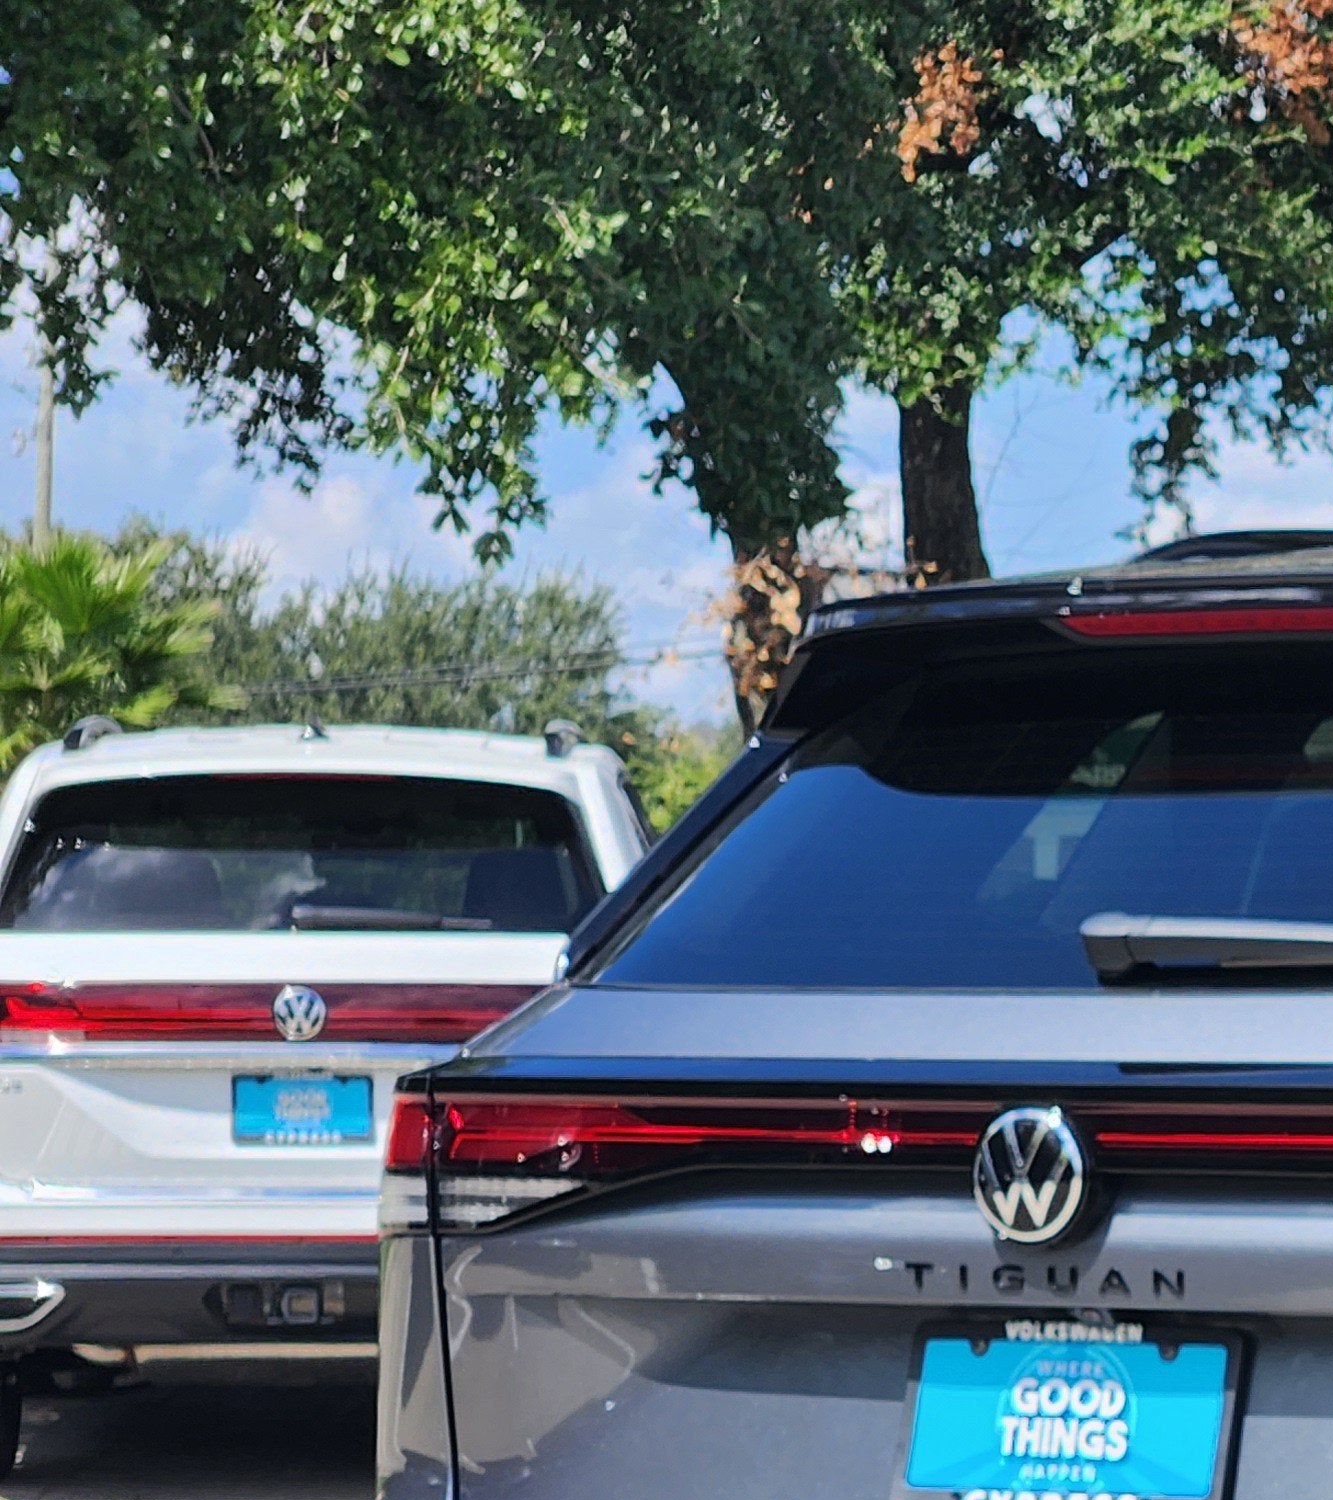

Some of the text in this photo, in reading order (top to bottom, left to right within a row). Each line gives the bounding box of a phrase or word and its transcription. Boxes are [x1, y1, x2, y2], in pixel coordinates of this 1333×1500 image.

[905, 1263, 1184, 1298] TIGUAN
[1012, 1377, 1126, 1418] GOOD
[1002, 1416, 1128, 1461] THINGS
